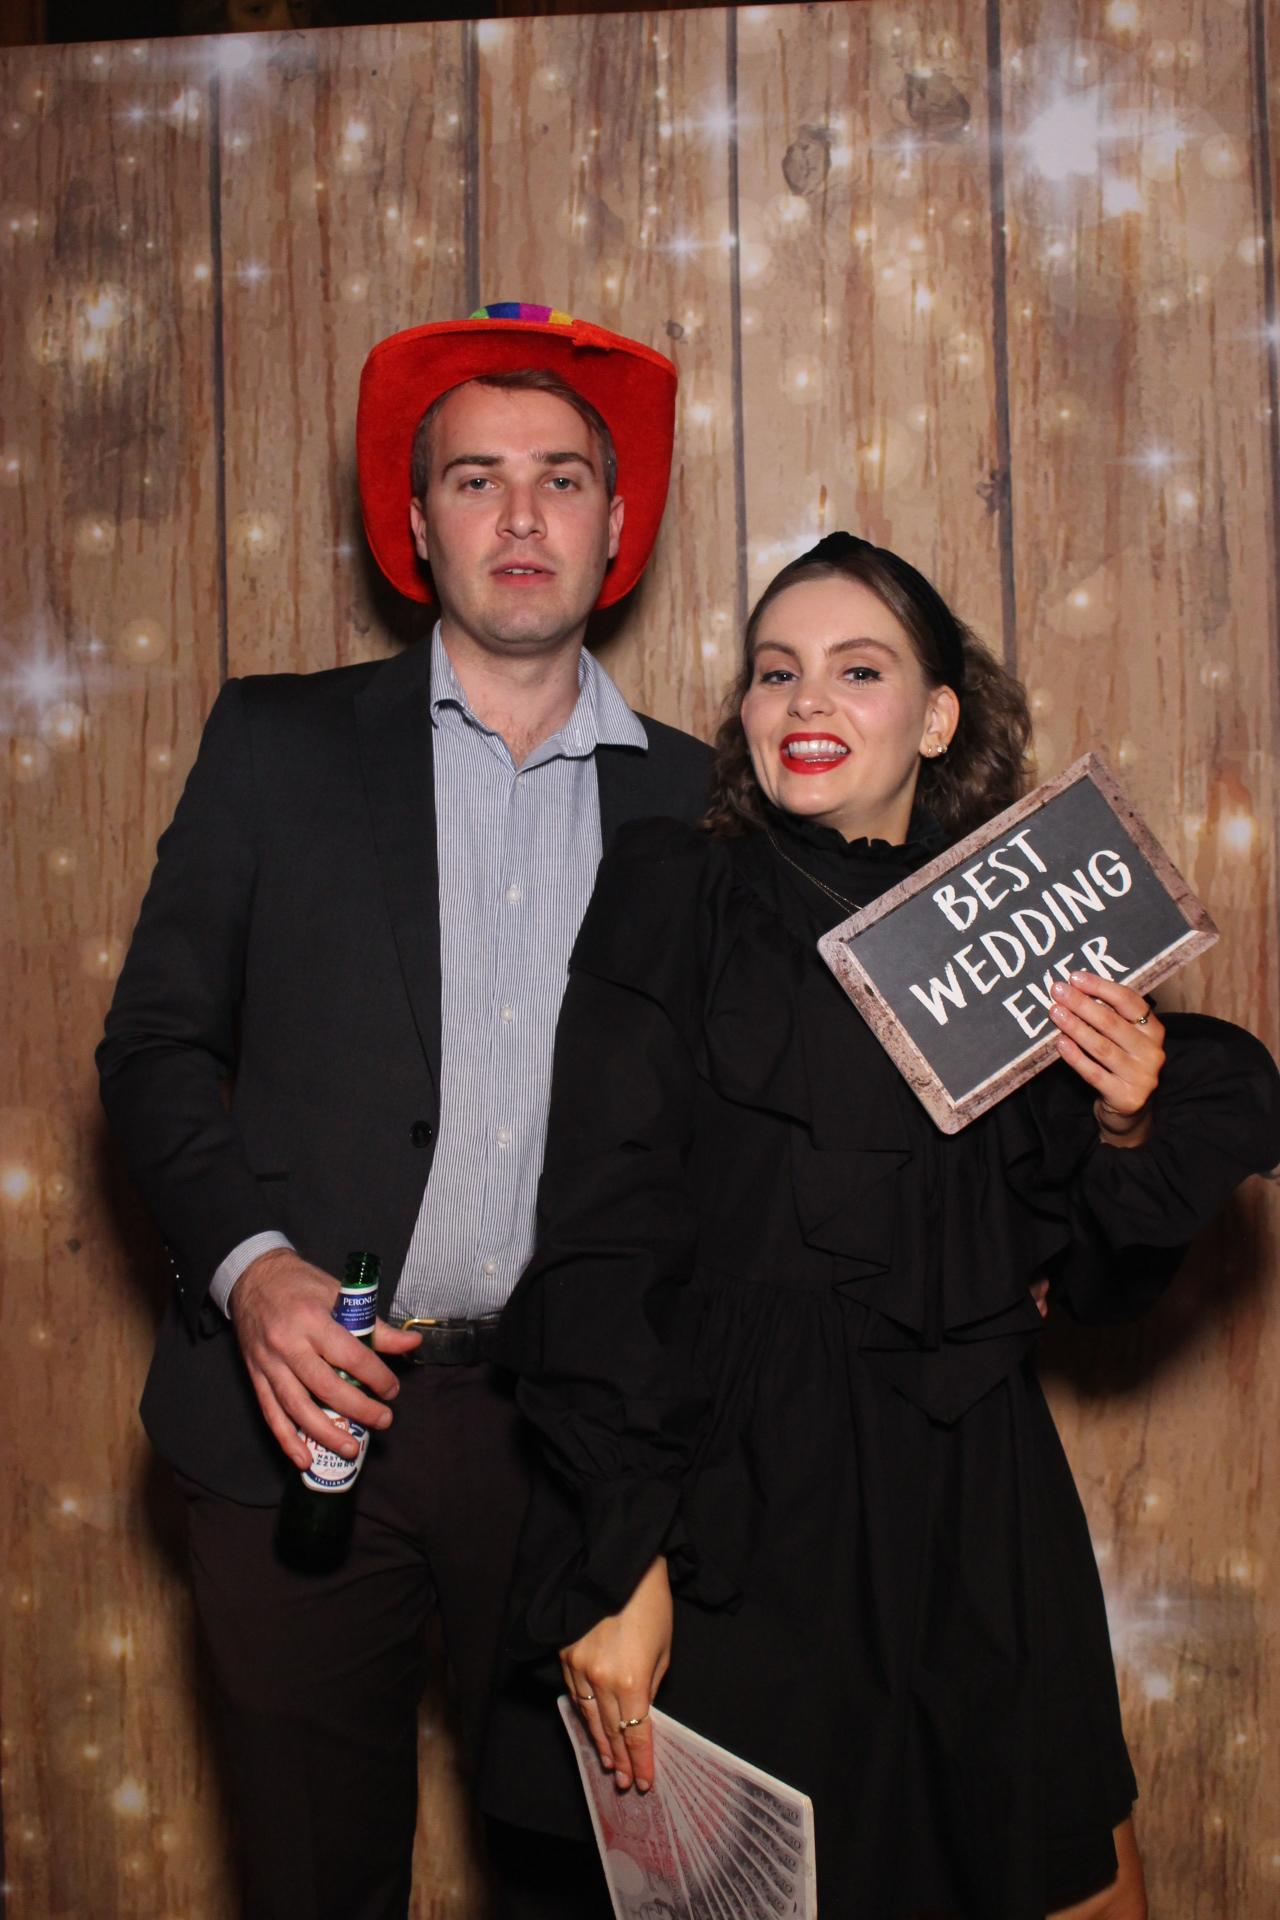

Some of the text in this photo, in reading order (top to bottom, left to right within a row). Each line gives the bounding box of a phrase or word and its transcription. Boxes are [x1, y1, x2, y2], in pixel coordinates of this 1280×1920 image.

[933, 829, 1047, 932] BEST
[909, 849, 1133, 1026] WEDDING
[343, 1296, 372, 1306] PERONI
[312, 1459, 356, 1468] ZZURRO
